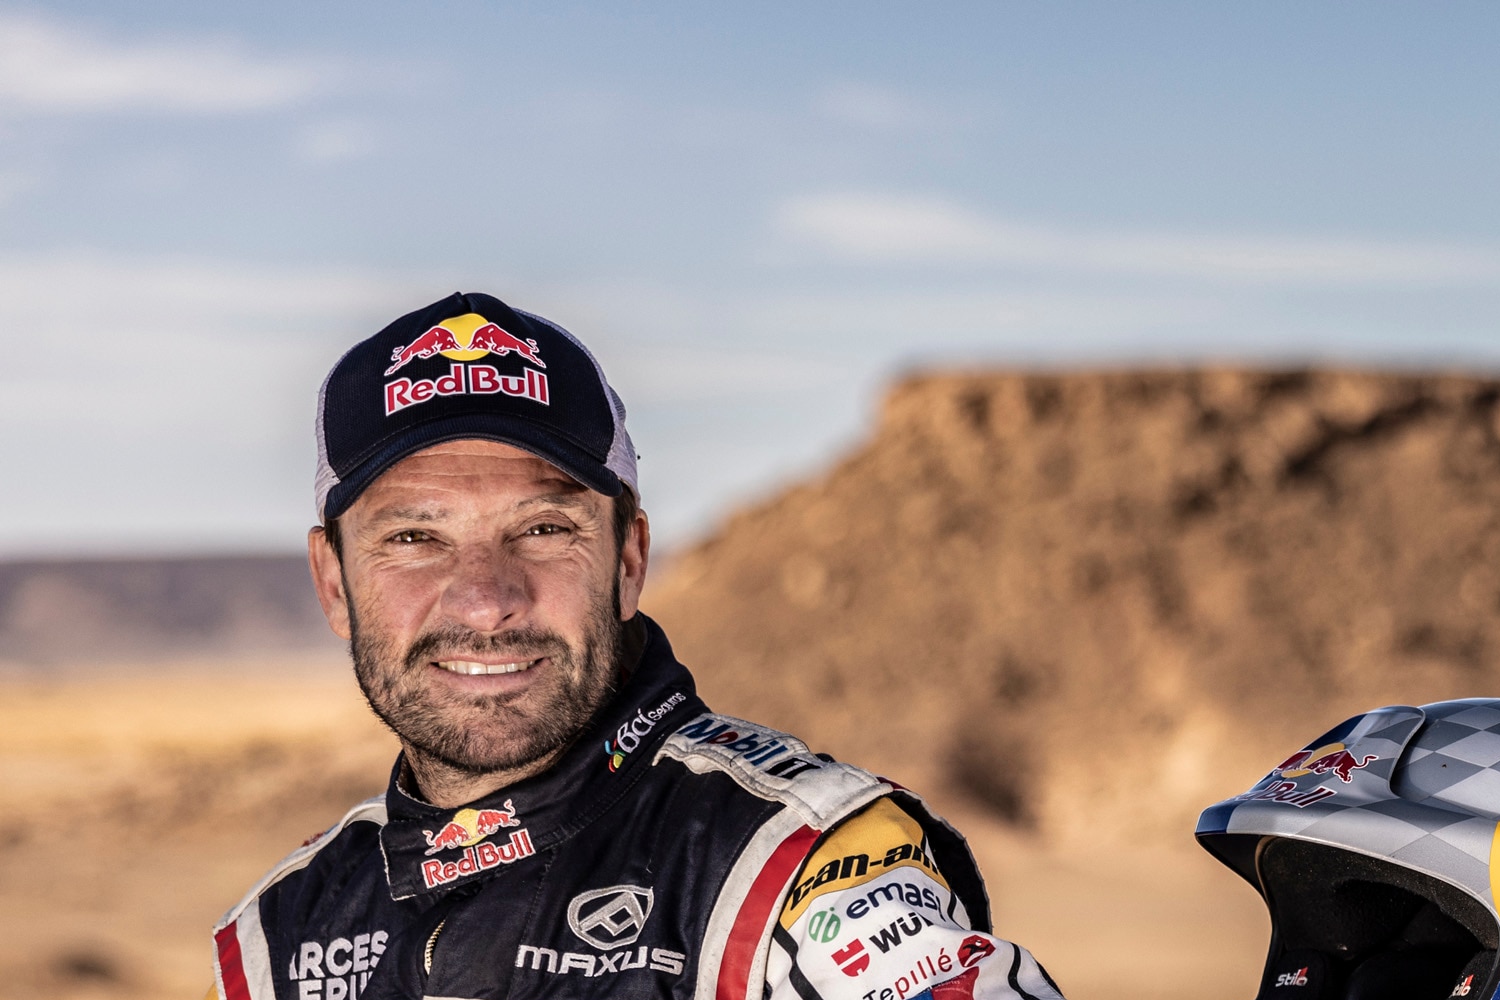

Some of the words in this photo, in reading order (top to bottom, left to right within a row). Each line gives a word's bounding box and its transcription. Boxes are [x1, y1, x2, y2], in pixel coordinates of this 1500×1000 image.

[384, 364, 465, 416] Red
[468, 365, 549, 405] Bull
[677, 718, 788, 766] Mobil
[421, 847, 479, 889] Red
[476, 828, 536, 870] Bull
[846, 883, 945, 922] emas
[515, 944, 686, 978] MAXUS
[1451, 975, 1474, 997] tilo
